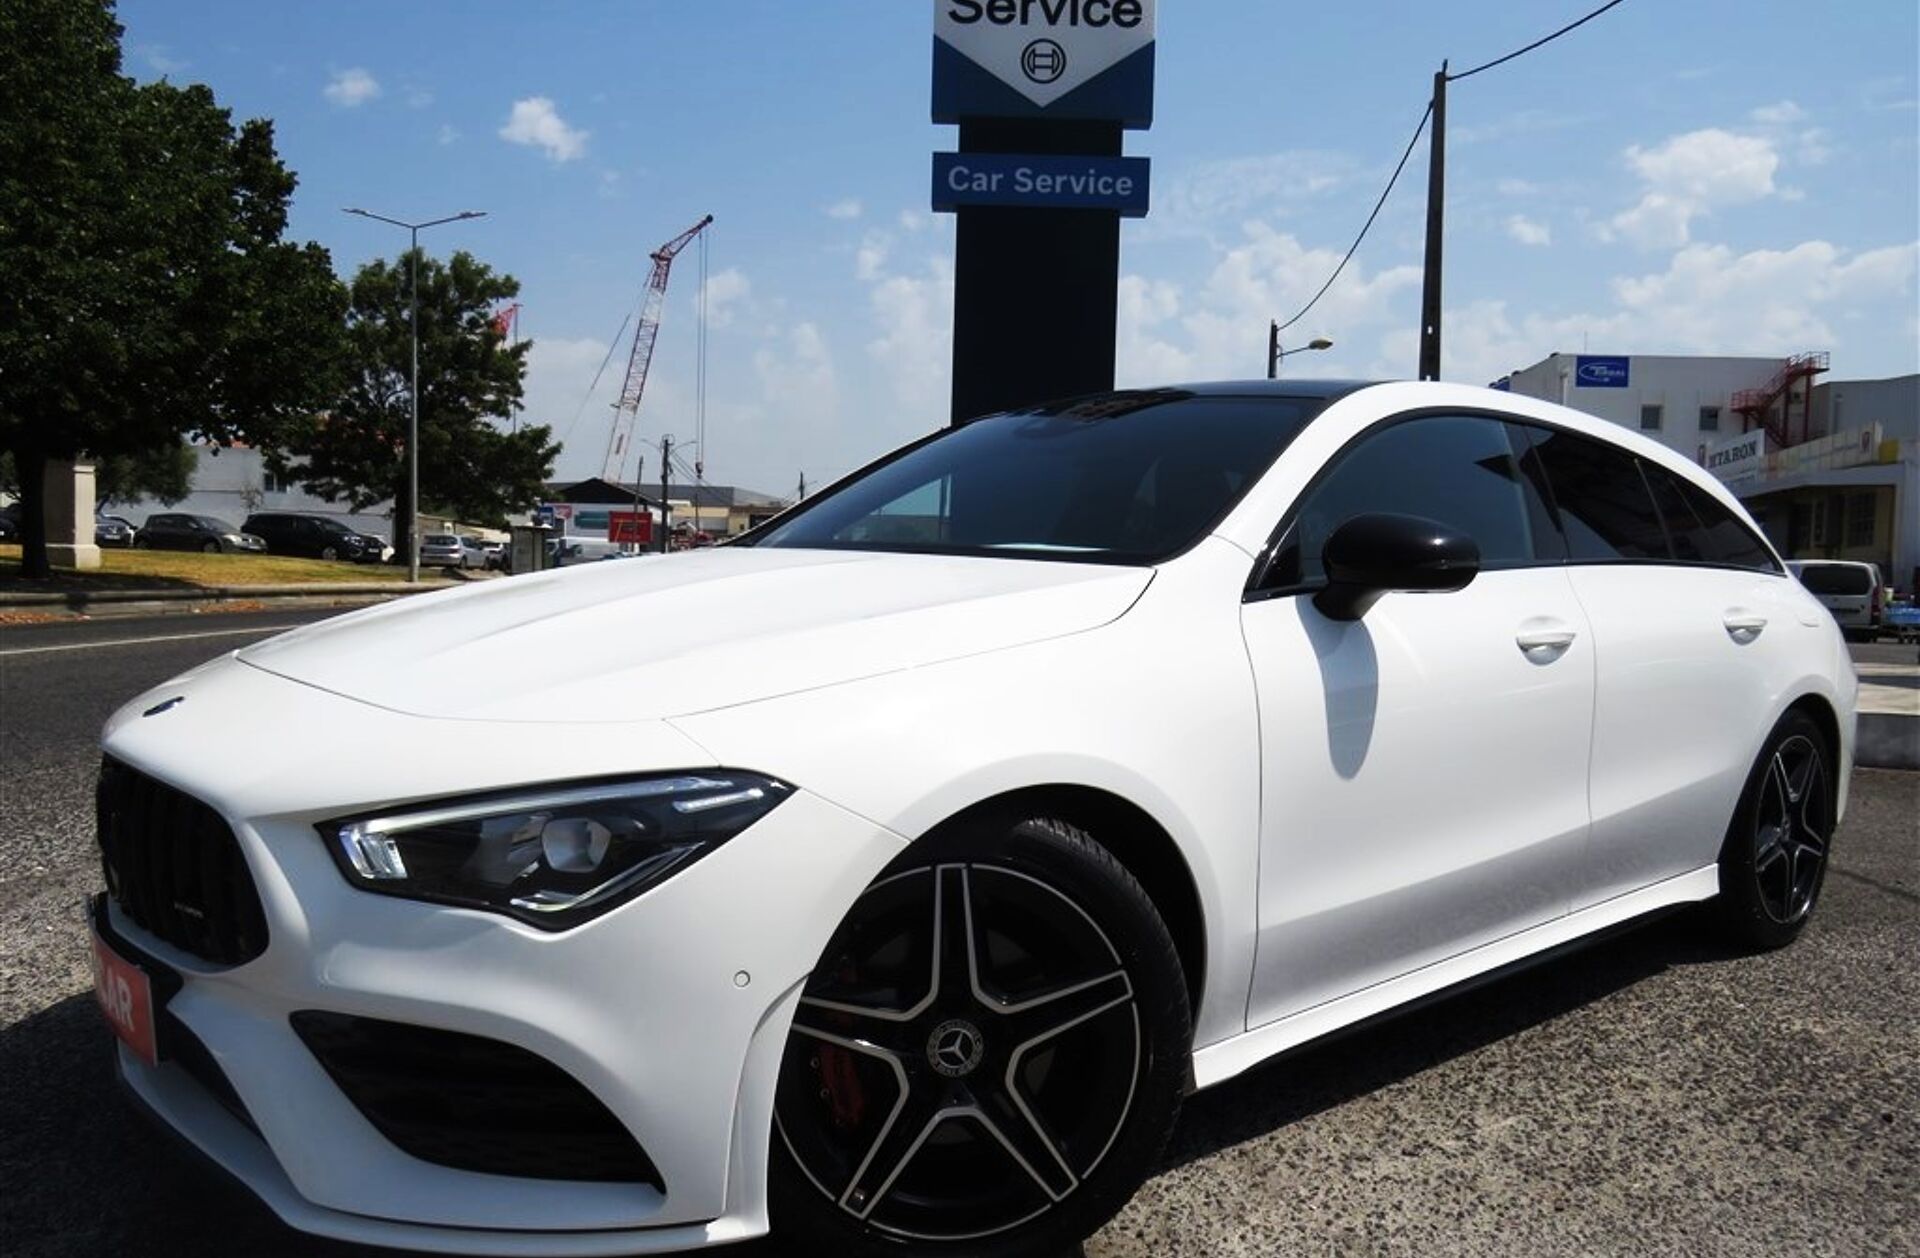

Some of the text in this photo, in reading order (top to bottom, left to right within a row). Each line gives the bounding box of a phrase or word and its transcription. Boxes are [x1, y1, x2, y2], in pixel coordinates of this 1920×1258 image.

[948, 0, 1143, 28] Service
[949, 166, 1133, 195] Car Service
